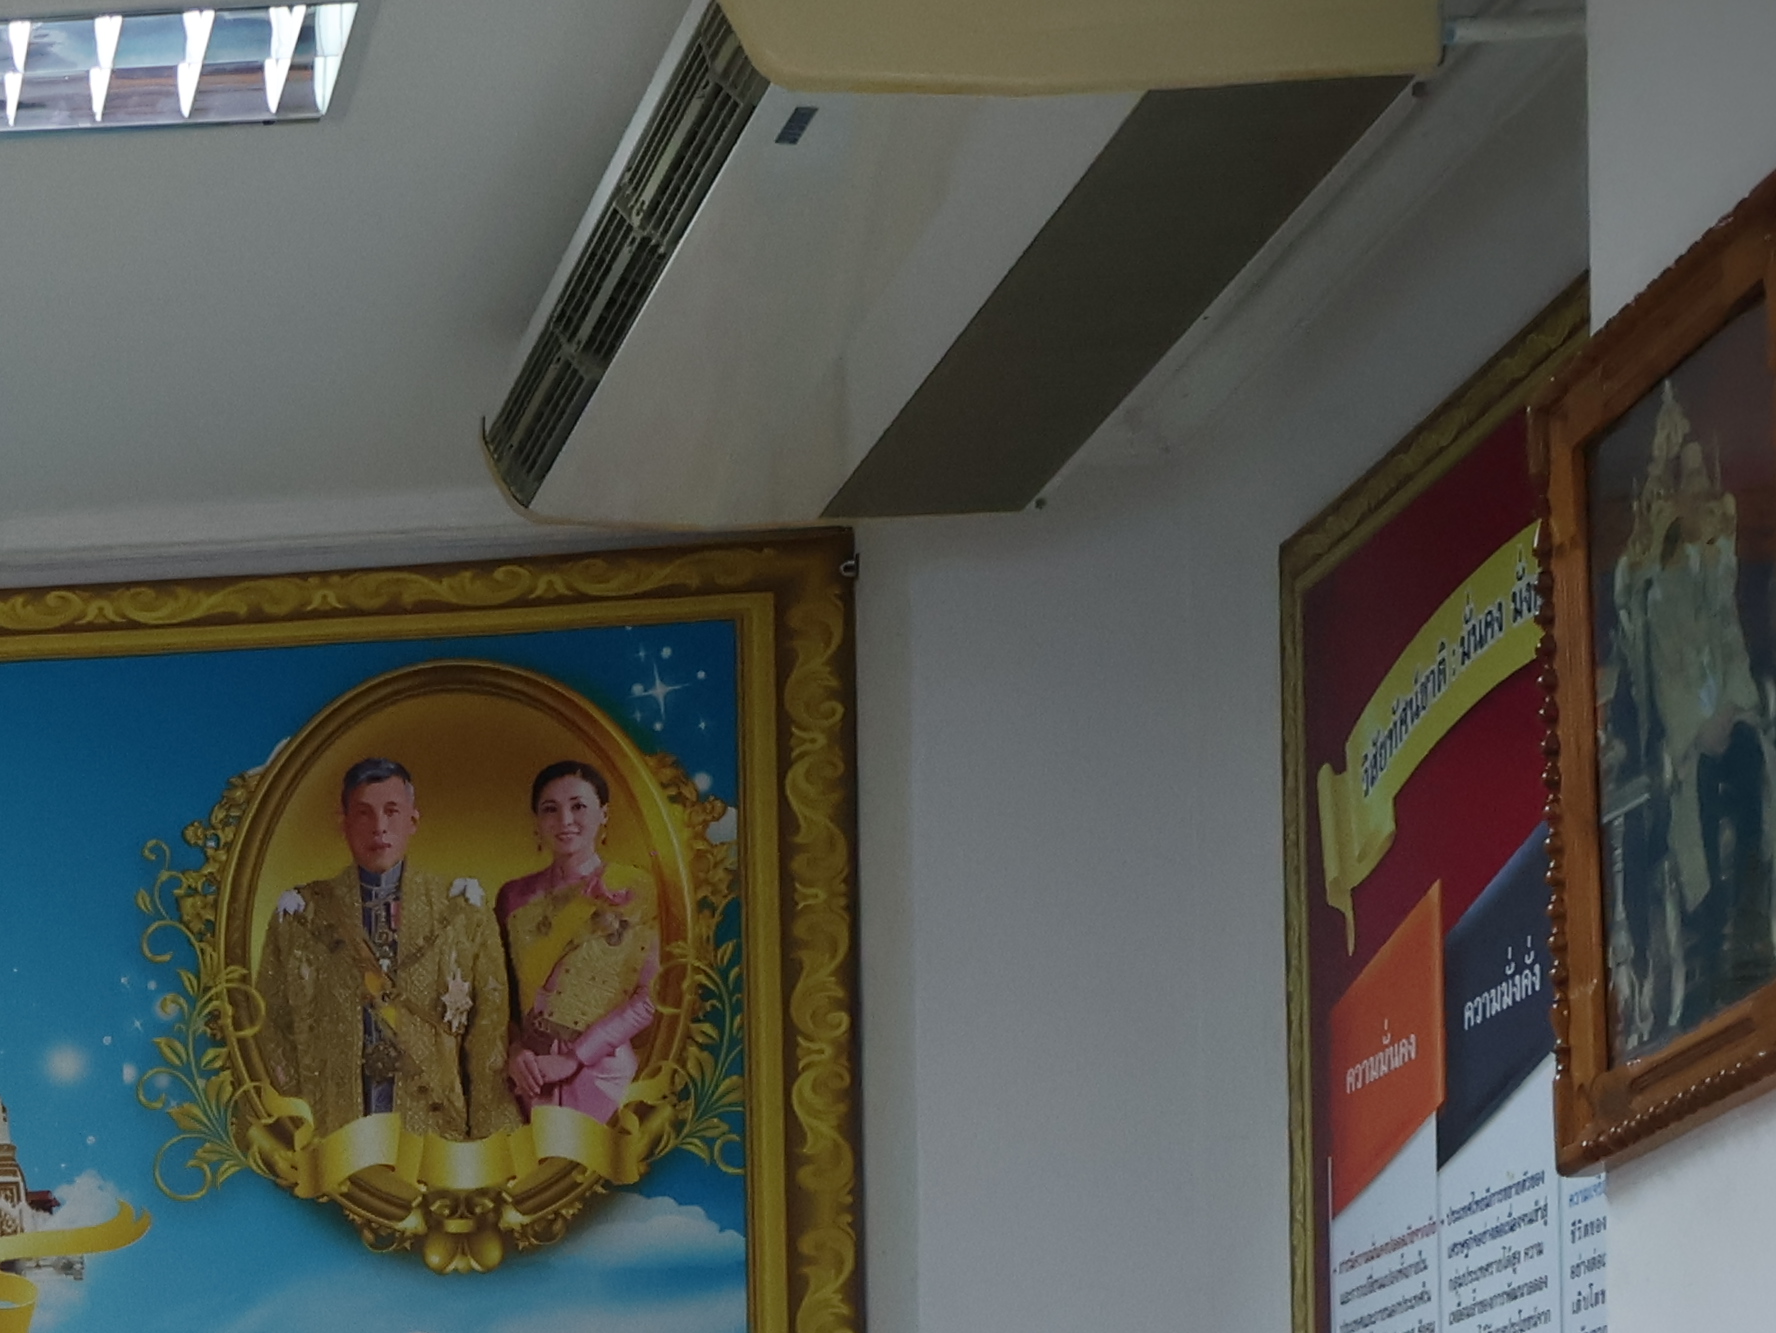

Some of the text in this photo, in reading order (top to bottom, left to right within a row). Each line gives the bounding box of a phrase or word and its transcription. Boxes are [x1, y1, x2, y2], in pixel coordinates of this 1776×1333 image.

[1463, 936, 1542, 1032] ความมั่งคั่ง
[1345, 1020, 1418, 1095] ความมั่นคง
